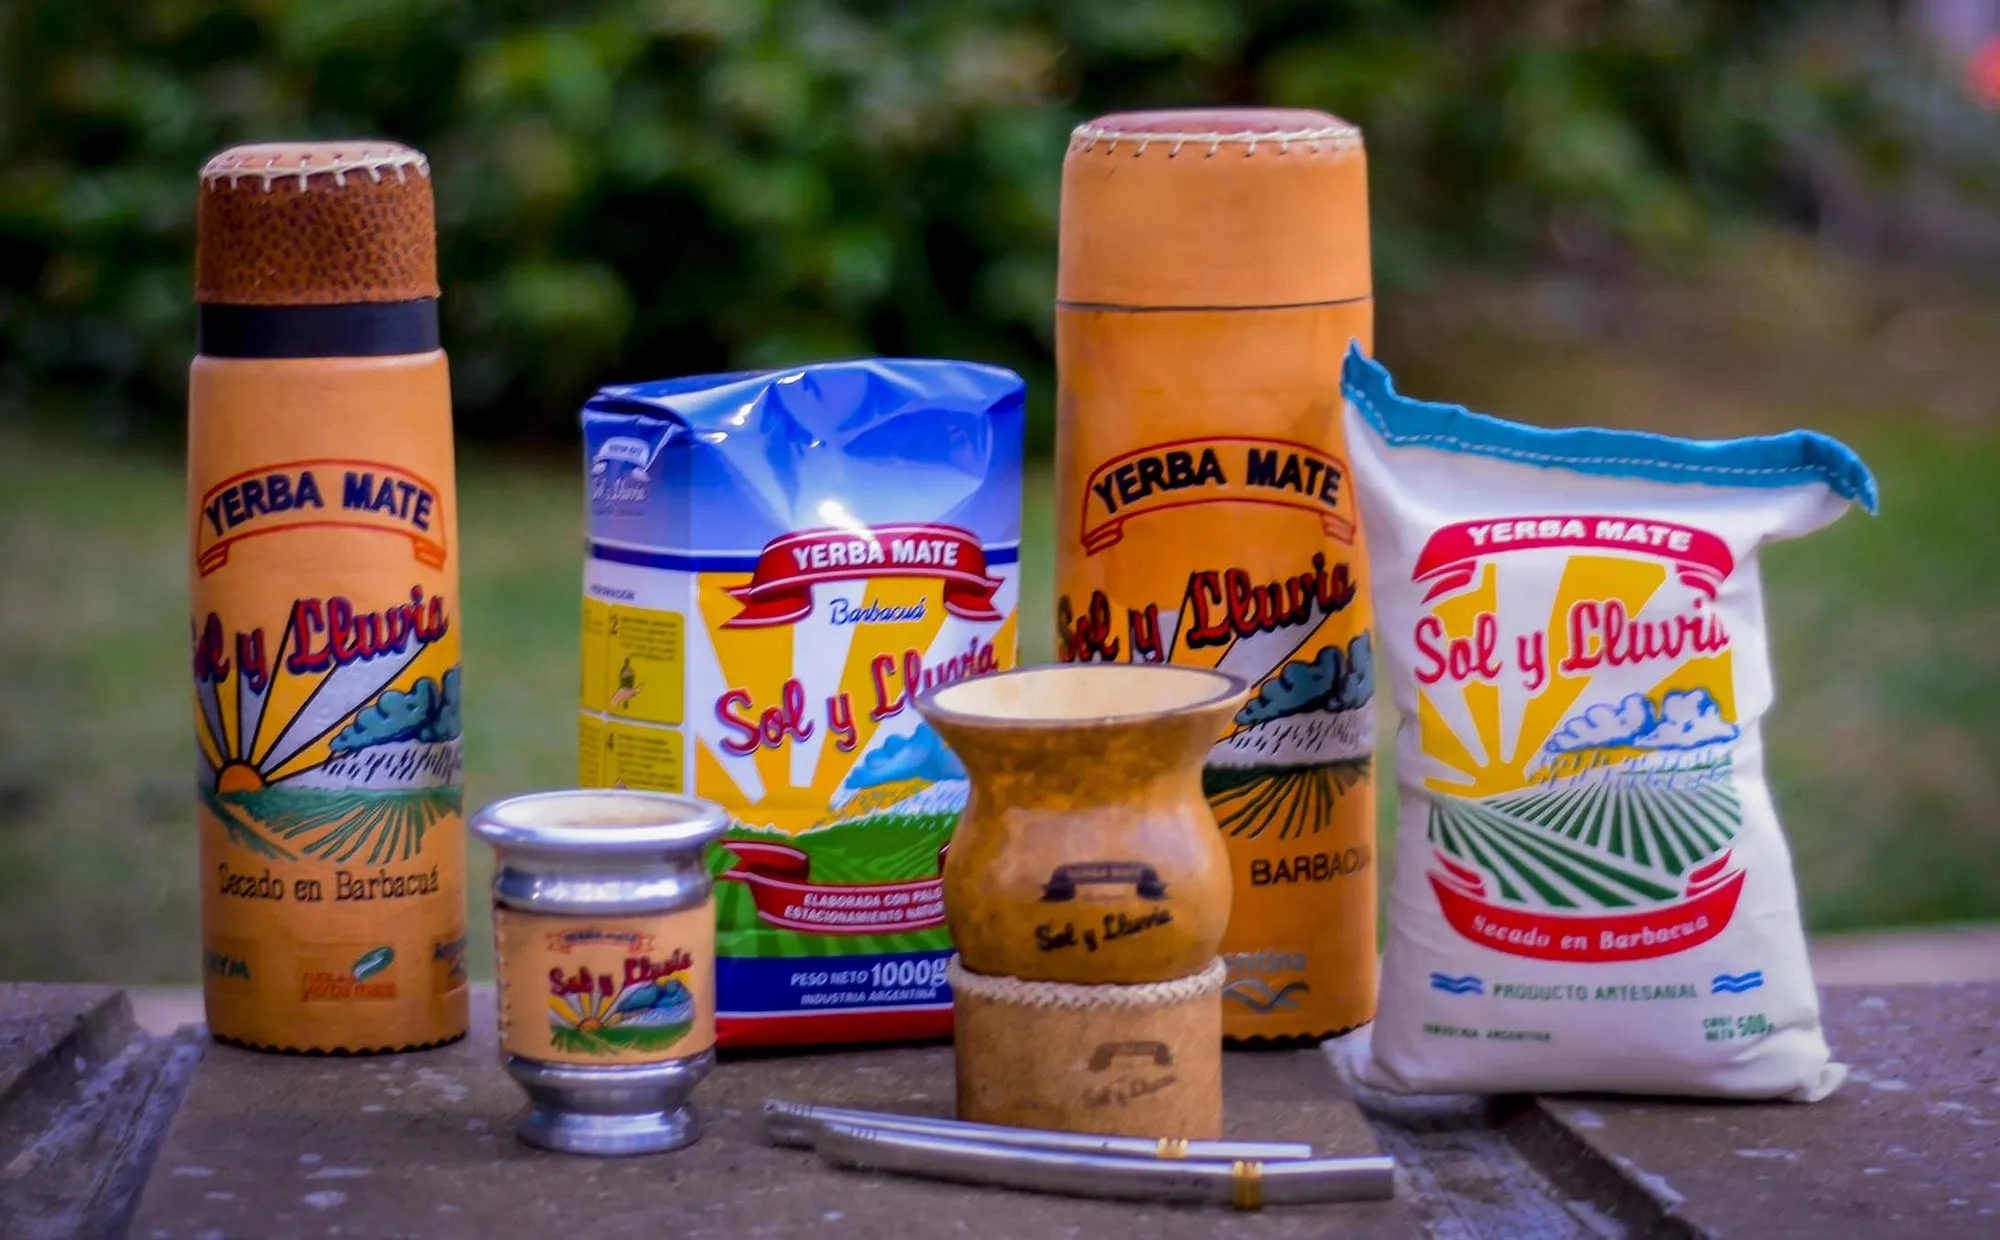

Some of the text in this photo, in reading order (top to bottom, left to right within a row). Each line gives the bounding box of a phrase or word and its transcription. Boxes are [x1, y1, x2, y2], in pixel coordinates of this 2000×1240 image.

[1092, 447, 1342, 514] YERBA MATE
[204, 470, 435, 537] YERBA MATE
[1466, 518, 1694, 551] YERBA MATE
[792, 539, 960, 570] YERBA MATE
[1186, 552, 1356, 649] Lluvia
[239, 627, 268, 695] y
[286, 584, 449, 675] Lluvia
[1414, 610, 1503, 684] Sol
[1516, 629, 1546, 690] y
[715, 676, 815, 756] Sol
[826, 690, 858, 752] y
[294, 878, 323, 902] en
[1471, 914, 1551, 948] Secado
[1560, 933, 1589, 951] en
[791, 958, 949, 988] PESO NETO 1000g
[801, 991, 866, 1006] INDUSTRIA
[1493, 982, 1699, 1002] PRODUCTO ARTESANAL
